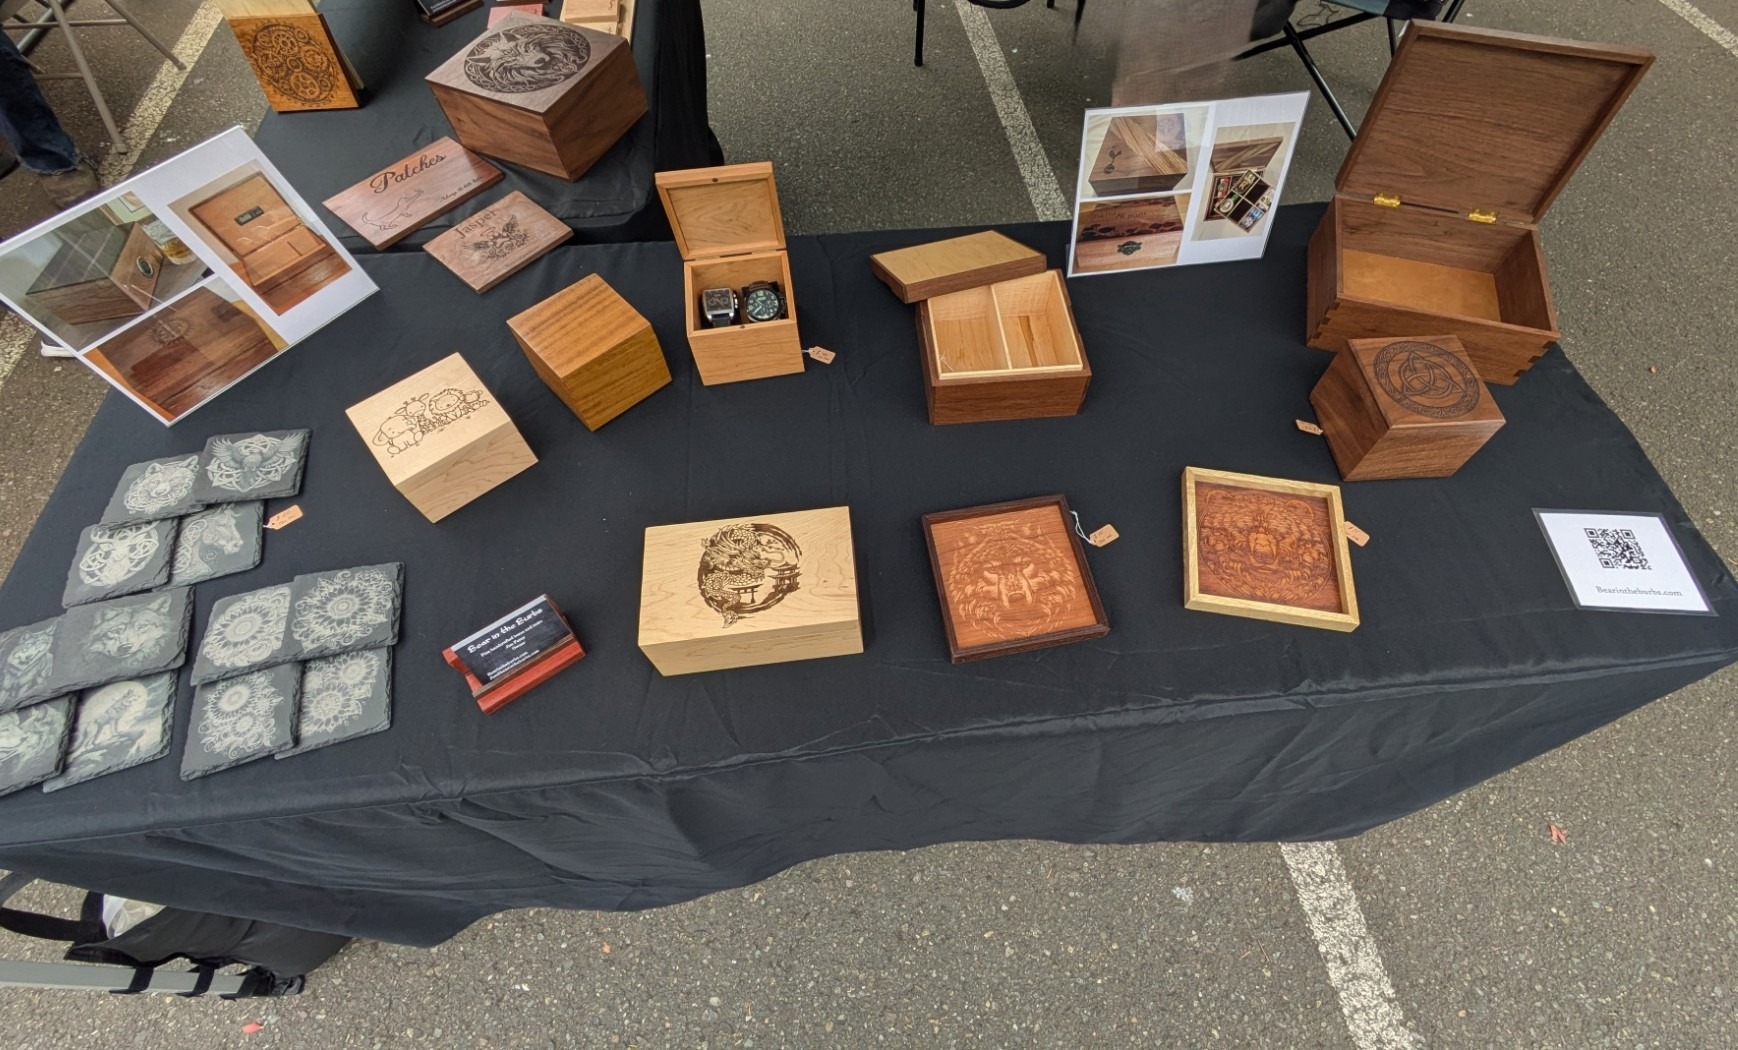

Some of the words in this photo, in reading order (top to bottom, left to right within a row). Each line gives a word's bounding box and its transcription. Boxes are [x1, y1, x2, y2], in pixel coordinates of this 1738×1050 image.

[369, 152, 447, 194] Patches
[454, 208, 497, 239] Jasper
[1596, 586, 1683, 597] Bearintheburbs.com
[467, 637, 491, 654] Bear
[500, 624, 516, 634] the
[516, 608, 543, 626] Burbs
